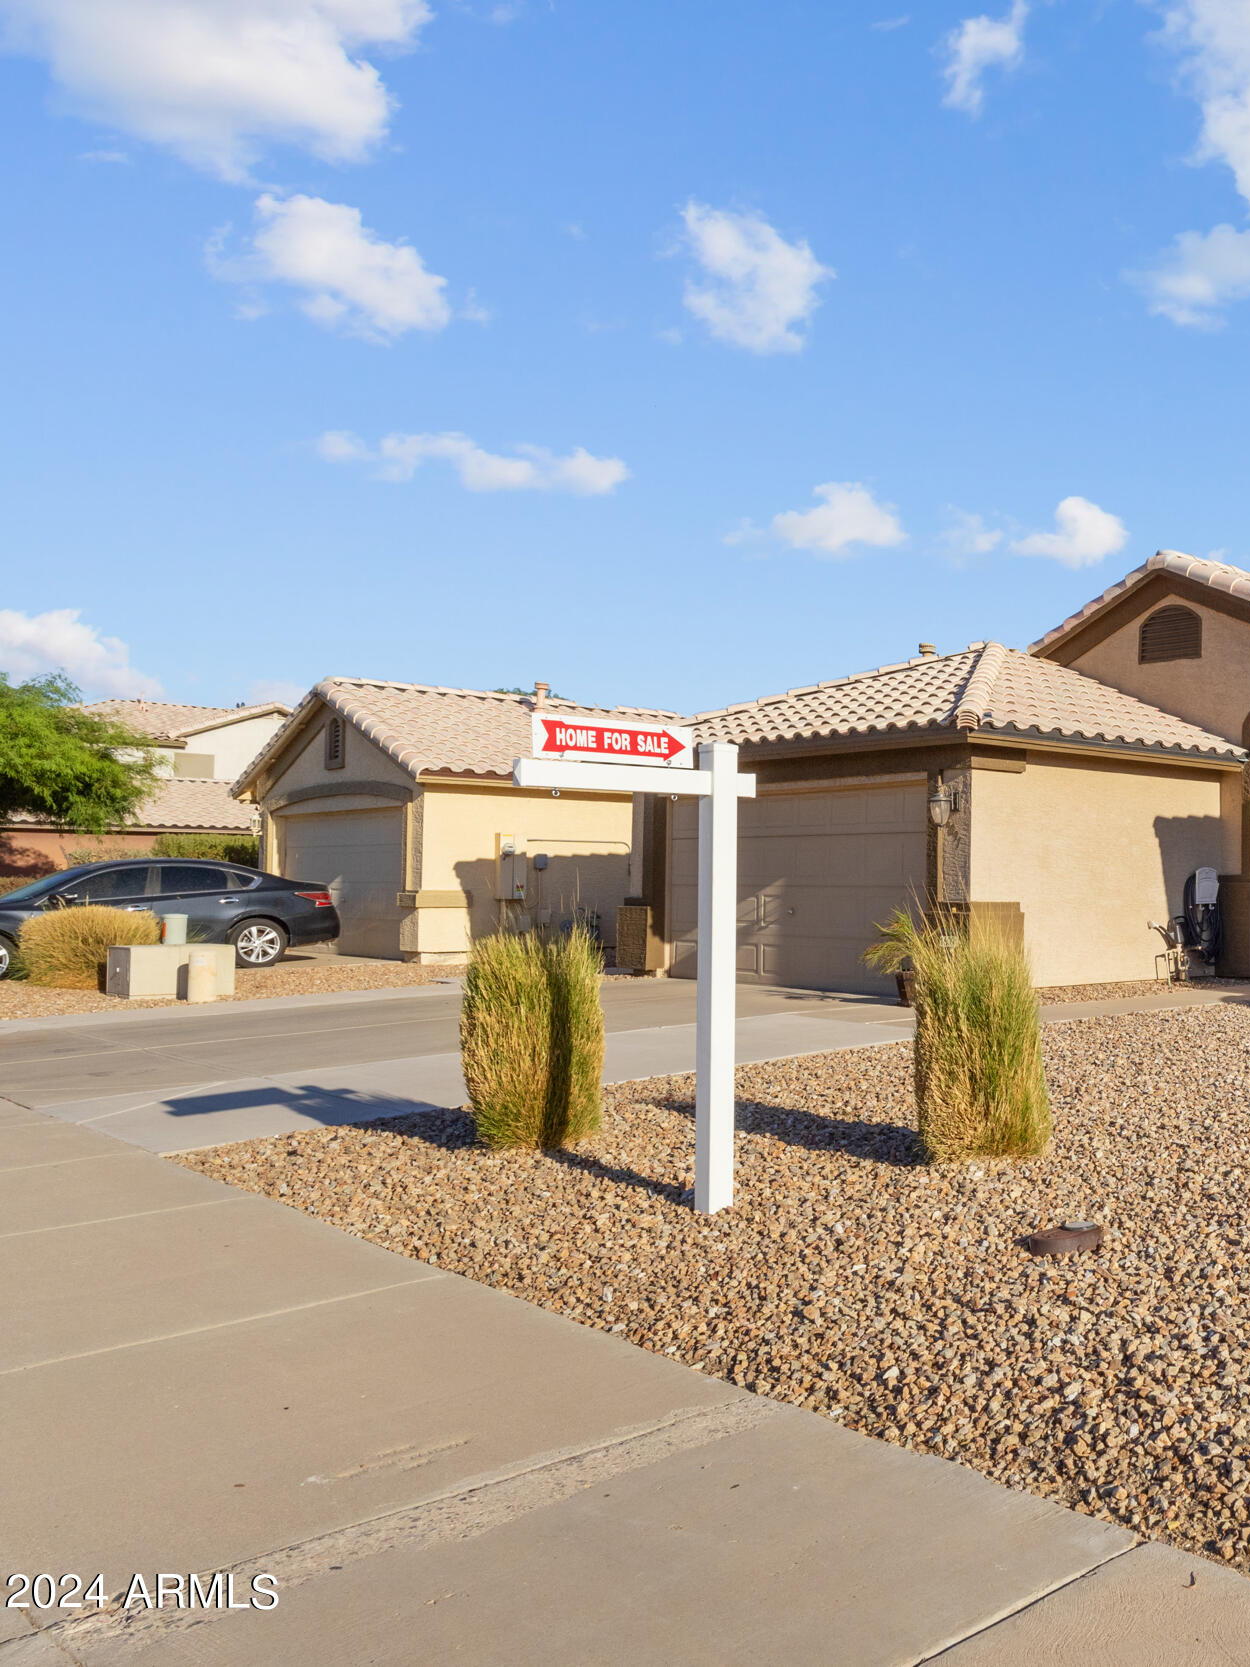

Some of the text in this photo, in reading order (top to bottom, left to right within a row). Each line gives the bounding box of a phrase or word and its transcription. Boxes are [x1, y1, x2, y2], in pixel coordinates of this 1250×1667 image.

[556, 728, 669, 754] HOME FOR SALE
